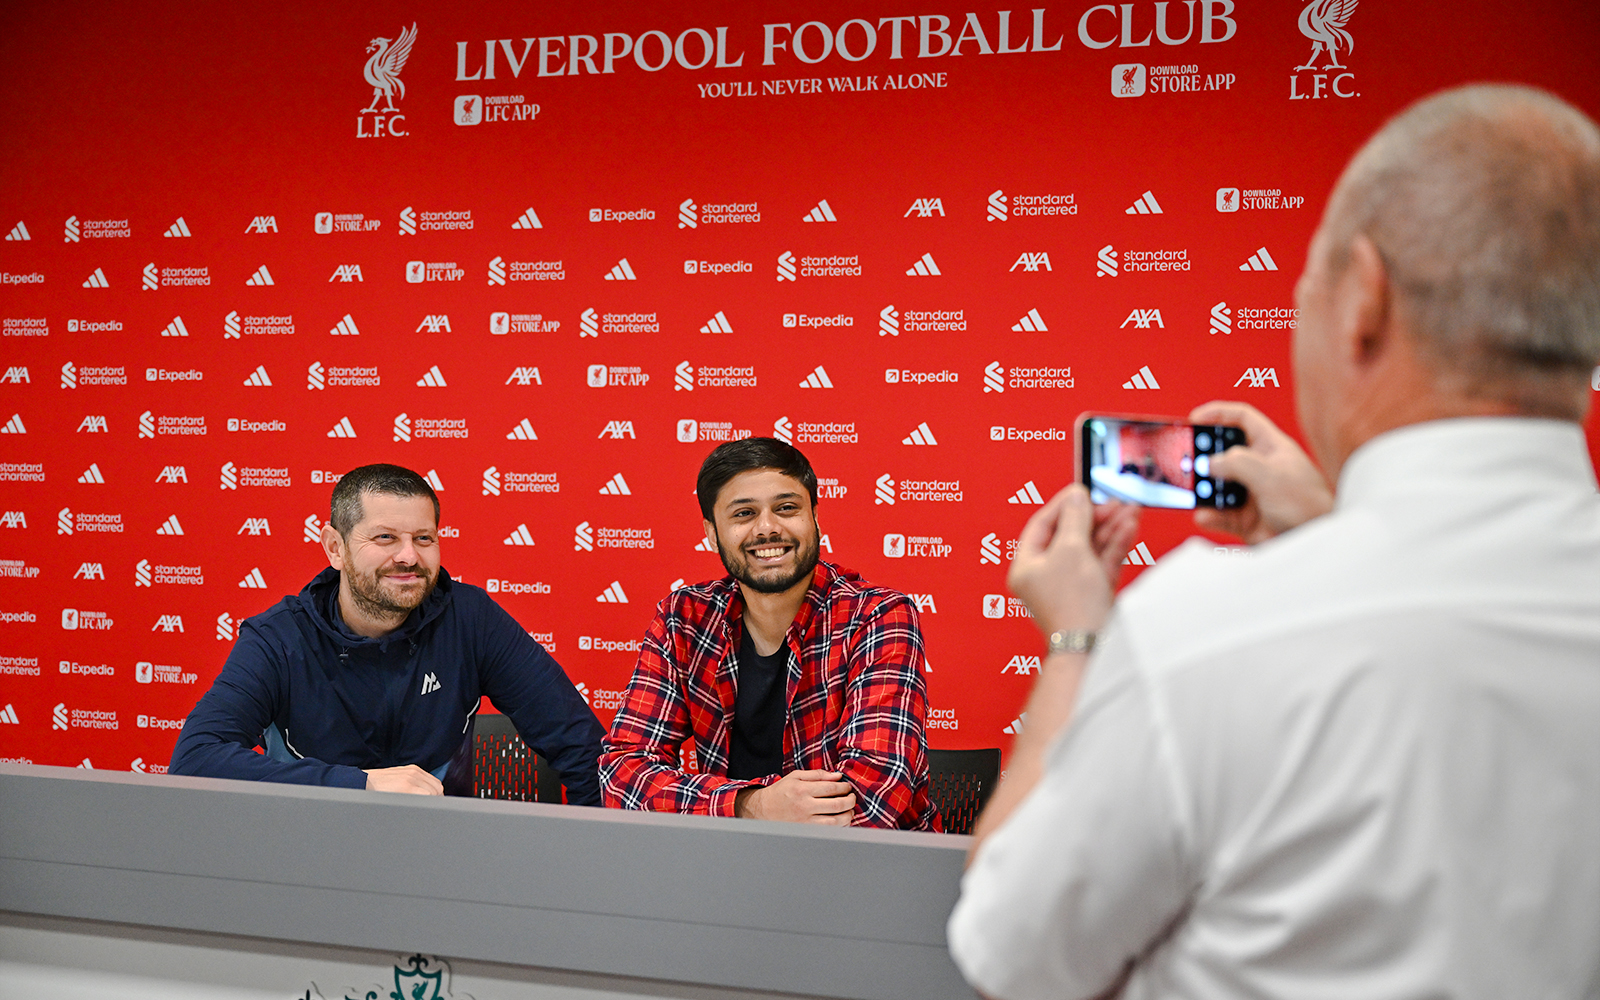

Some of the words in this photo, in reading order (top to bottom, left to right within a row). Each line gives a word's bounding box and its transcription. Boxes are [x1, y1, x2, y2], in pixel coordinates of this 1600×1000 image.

[455, 27, 744, 82] LIVERPOOL
[762, 9, 1063, 65] FOOTBALL
[1078, 0, 1237, 49] CLUB
[1150, 65, 1198, 76] DOWNLOAD
[698, 82, 757, 98] YOU'LL
[762, 79, 822, 95] NEVER
[827, 76, 878, 92] WALK
[883, 72, 947, 90] ALONE
[1150, 75, 1200, 93] STORE
[1204, 73, 1235, 90] APP
[1288, 73, 1360, 100] L.F.C.
[485, 95, 524, 105] DOWNLOAD
[485, 105, 510, 122] LFC
[512, 104, 540, 121] APP
[356, 114, 409, 138] L.F.C.
[1243, 189, 1281, 197] DOWNLOAD
[1013, 194, 1074, 205] standard
[1243, 197, 1279, 210] STORE
[1281, 196, 1304, 209] APP
[702, 202, 757, 213] standard
[904, 198, 945, 217] AXA
[1013, 204, 1077, 216] chartered
[420, 210, 471, 221] standard
[604, 209, 655, 223] Expedia
[702, 212, 760, 224] chartered
[84, 219, 128, 229] standard
[245, 216, 278, 233] AXA
[335, 220, 362, 232] STORE
[363, 220, 381, 231] APP
[420, 220, 474, 231] chartered
[83, 228, 131, 238] chartered
[801, 255, 858, 266] standard
[1124, 249, 1187, 261] standard
[510, 260, 562, 271] standard
[700, 261, 752, 275] Expedia
[1009, 252, 1052, 272] AXA
[1124, 260, 1190, 272] chartered
[162, 267, 208, 277] standard
[329, 265, 363, 282] AXA
[426, 269, 443, 281] LFC
[445, 269, 464, 281] APP
[510, 270, 565, 281] chartered
[801, 265, 861, 277] chartered
[3, 273, 44, 285] Expedia
[161, 276, 210, 286] chartered
[244, 315, 292, 325] standard
[603, 312, 656, 323] standard
[799, 314, 853, 329] Expedia
[904, 310, 963, 321] standard
[1120, 309, 1164, 328] AXA
[3, 318, 46, 327] standard
[80, 320, 123, 333] Expedia
[416, 315, 451, 333] AXA
[511, 321, 540, 332] STORE
[541, 321, 560, 332] APP
[602, 322, 659, 333] chartered
[904, 320, 967, 331] chartered
[3, 327, 49, 336] chartered
[244, 325, 295, 334] chartered
[0, 367, 30, 383] AXA
[80, 366, 124, 376] standard
[159, 369, 203, 382] Expedia
[328, 366, 377, 377] standard
[505, 367, 542, 385] AXA
[698, 366, 753, 376] standard
[902, 370, 958, 384] Expedia
[1010, 367, 1070, 377] standard
[79, 376, 127, 385] chartered
[328, 376, 380, 386] chartered
[609, 373, 627, 386] LFC
[628, 373, 649, 386] APP
[698, 376, 757, 387] chartered
[1009, 377, 1074, 388] chartered
[1234, 368, 1280, 387] AXA
[77, 416, 108, 433] AXA
[158, 416, 204, 426] standard
[241, 419, 286, 433] Expedia
[415, 418, 465, 428] standard
[158, 425, 207, 435] chartered
[414, 428, 468, 438] chartered
[598, 421, 636, 439] AXA
[797, 422, 854, 433] standard
[699, 429, 730, 441] STORE
[797, 432, 858, 443] chartered
[1008, 427, 1065, 442] Expedia
[155, 466, 188, 483] AXA
[241, 467, 288, 477] standard
[505, 472, 557, 483] standard
[240, 477, 291, 487] chartered
[504, 482, 560, 492] chartered
[817, 478, 838, 486] NLOAD
[900, 479, 959, 491] standard
[825, 485, 847, 498] APP
[900, 490, 963, 502] chartered
[0, 511, 27, 528] AXA
[77, 513, 121, 523] standard
[76, 522, 124, 532] chartered
[238, 518, 271, 536] AXA
[597, 527, 651, 539] standard
[597, 537, 654, 549] chartered
[908, 544, 927, 557] LFC
[929, 545, 952, 557] APP
[24, 567, 40, 578] APP
[74, 563, 105, 580] AXA
[155, 565, 201, 575] standard
[154, 574, 203, 585] chartered
[501, 580, 551, 595] Expedia
[908, 594, 937, 614] XA
[0, 611, 36, 623] xpedia
[1007, 605, 1034, 618] STO
[80, 618, 95, 629] LFC
[96, 618, 113, 630] APP
[152, 615, 184, 633] AXA
[0, 656, 38, 667] tandard
[1001, 655, 1042, 677] AXA
[0, 665, 40, 676] hartered
[72, 662, 114, 676] Expedia
[154, 672, 180, 683] STORE
[180, 673, 198, 684] APP
[593, 689, 625, 700] stan
[71, 709, 116, 720] standard
[926, 707, 955, 718] dard
[71, 718, 118, 730] chartered
[150, 716, 186, 730] Exped
[925, 718, 959, 730] tered
